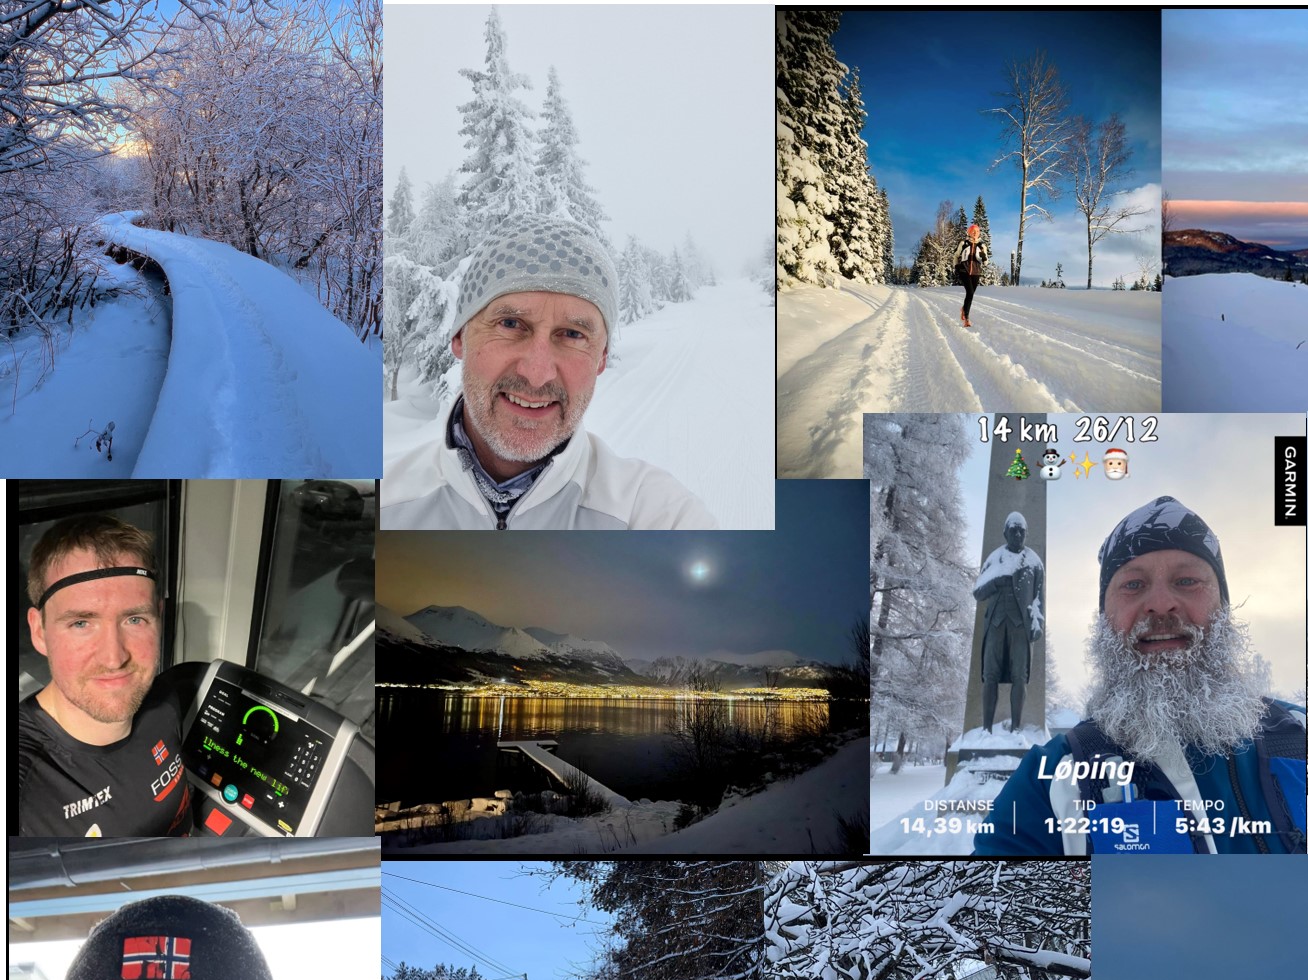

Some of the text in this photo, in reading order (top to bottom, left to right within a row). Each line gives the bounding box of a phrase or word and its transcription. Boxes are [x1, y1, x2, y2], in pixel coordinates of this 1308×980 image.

[151, 754, 182, 796] FOSS
[233, 754, 248, 769] the
[250, 767, 267, 781] new
[63, 786, 112, 819] TRIMTEX
